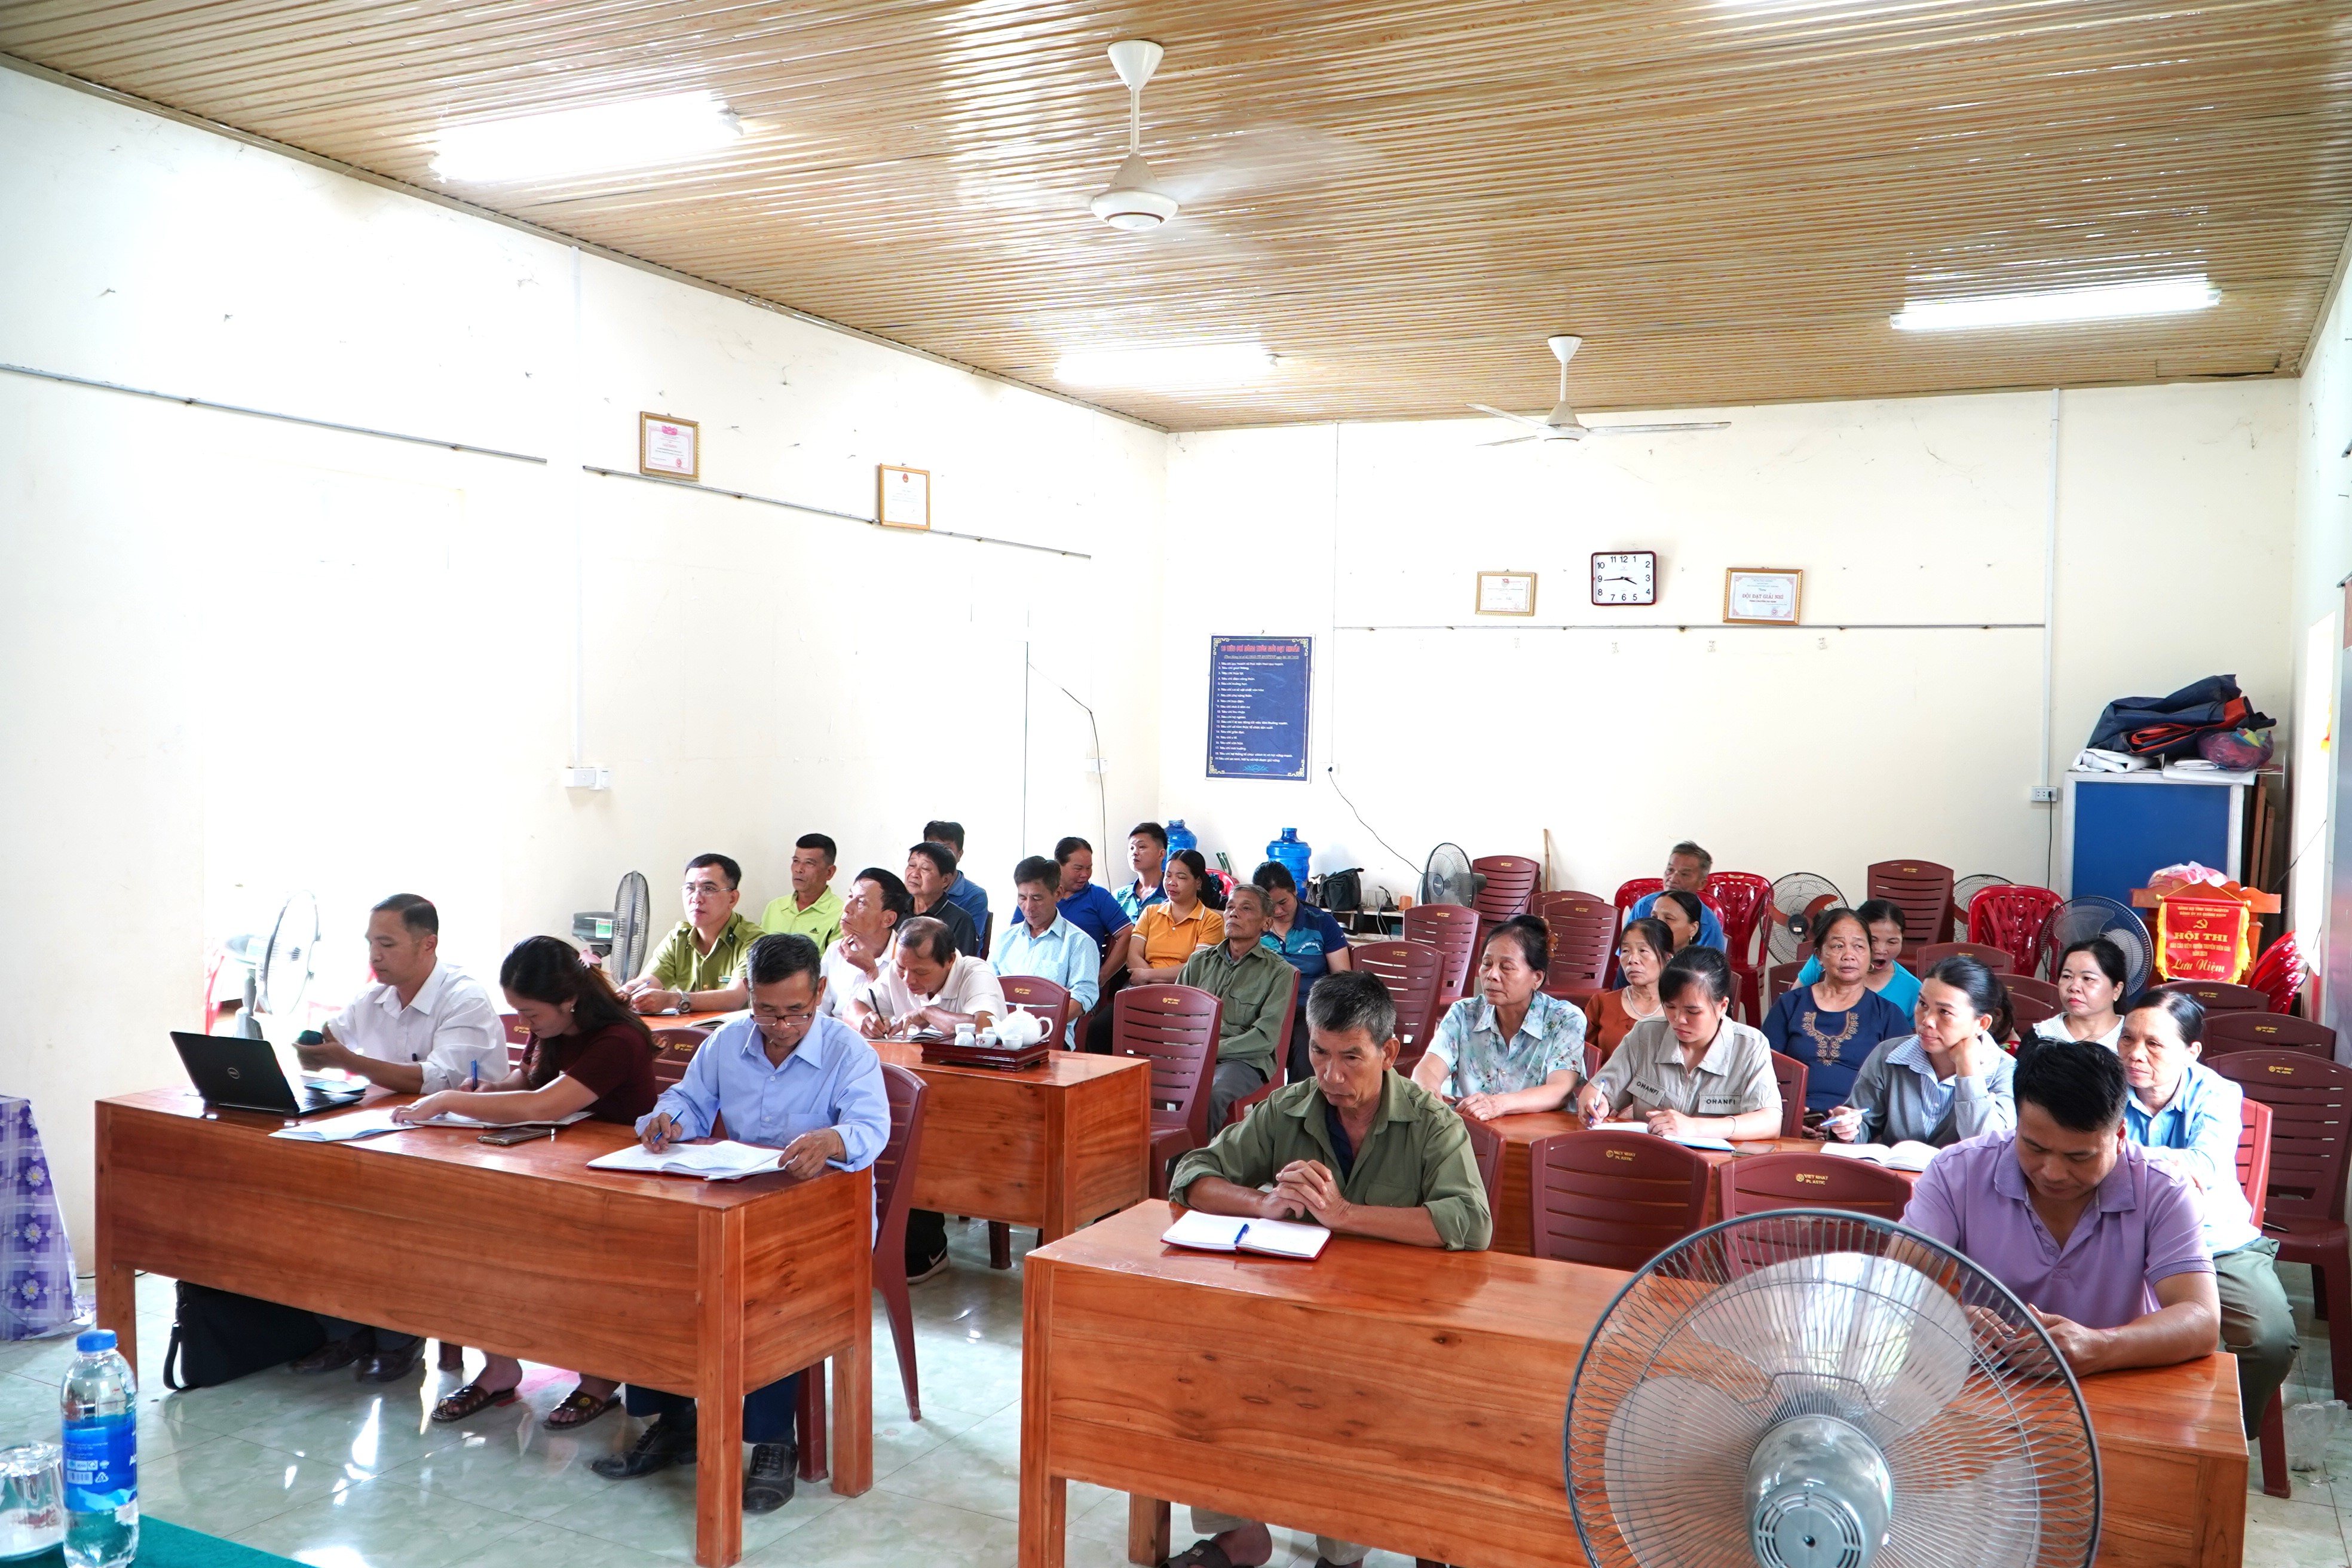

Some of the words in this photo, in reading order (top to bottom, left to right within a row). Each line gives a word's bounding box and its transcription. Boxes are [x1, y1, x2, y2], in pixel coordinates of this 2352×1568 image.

[2174, 930, 2199, 942] HỘI
[2203, 933, 2228, 942] THI
[2172, 958, 2193, 970] Lưu
[2196, 958, 2225, 973] Niệm
[1637, 1081, 1659, 1095] OHANFI
